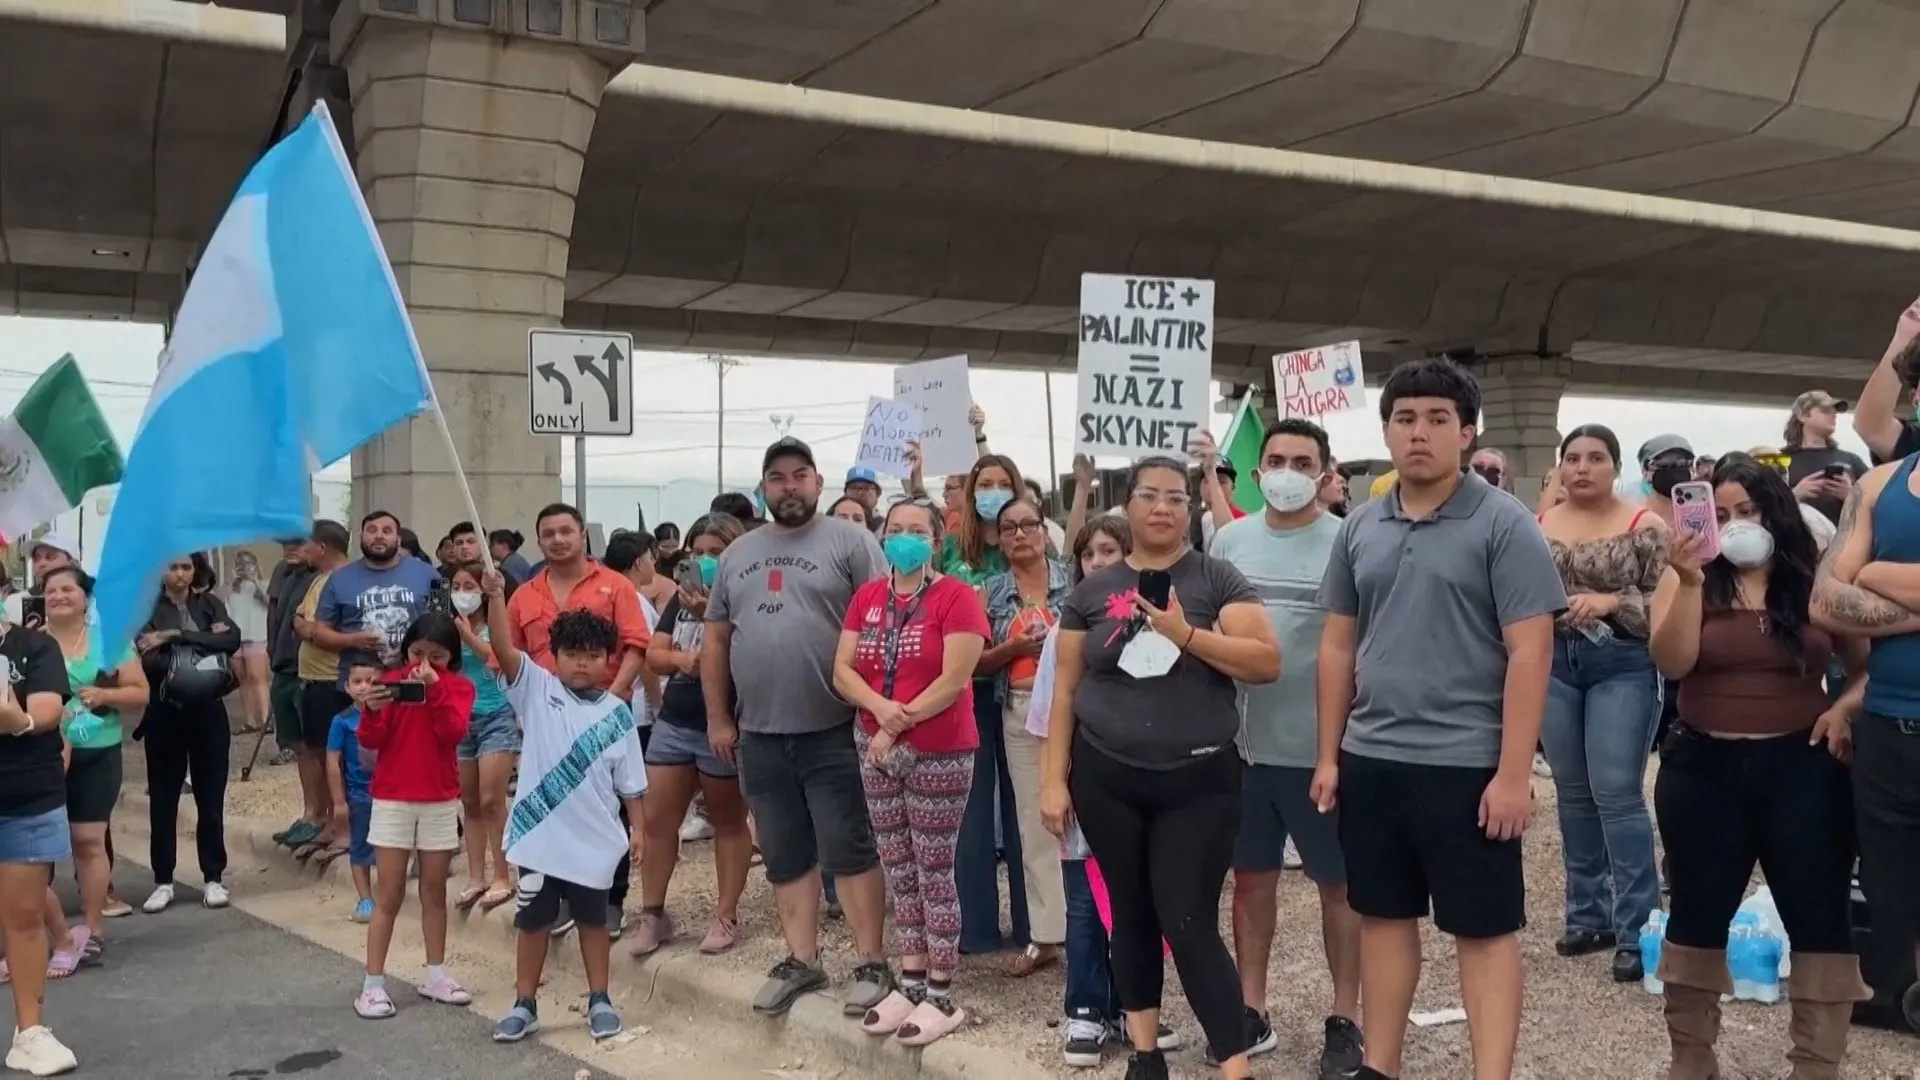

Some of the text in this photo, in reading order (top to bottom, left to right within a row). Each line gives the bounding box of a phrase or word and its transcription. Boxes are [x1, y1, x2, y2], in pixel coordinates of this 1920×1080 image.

[1124, 279, 1175, 310] ICE
[1081, 313, 1207, 351] PALINTIR
[1278, 349, 1326, 379] CHINGA
[1092, 373, 1184, 410] NAZI
[1283, 375, 1312, 400] LA
[869, 402, 909, 421] NO
[1286, 388, 1350, 421] MIGRA
[535, 413, 579, 428] ONLY
[1080, 412, 1198, 452] SKYNET
[739, 556, 818, 580] THE COOLEST
[757, 603, 783, 614] POP
